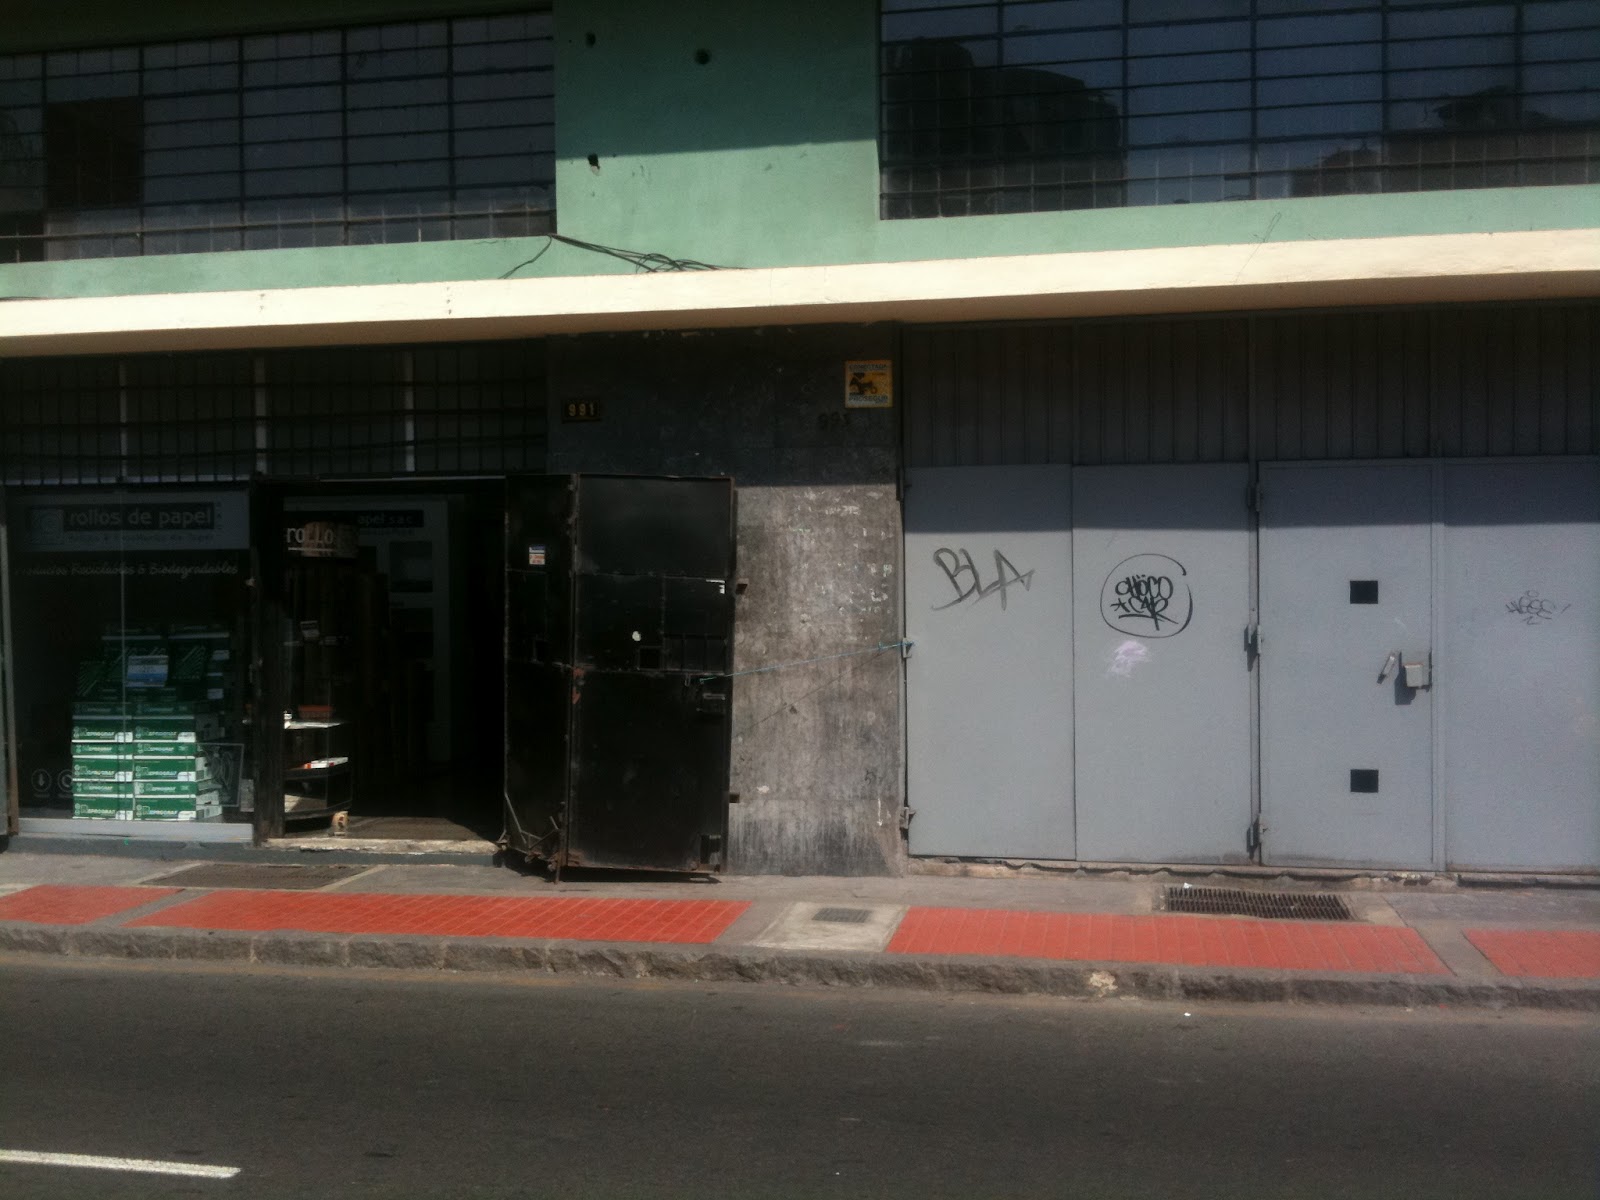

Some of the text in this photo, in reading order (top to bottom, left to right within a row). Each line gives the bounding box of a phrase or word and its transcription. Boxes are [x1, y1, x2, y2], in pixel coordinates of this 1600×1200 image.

[568, 402, 594, 417] 991
[69, 508, 121, 526] rollos
[127, 508, 152, 526] de
[158, 507, 212, 528] papel
[149, 559, 239, 580] Biodegradables
